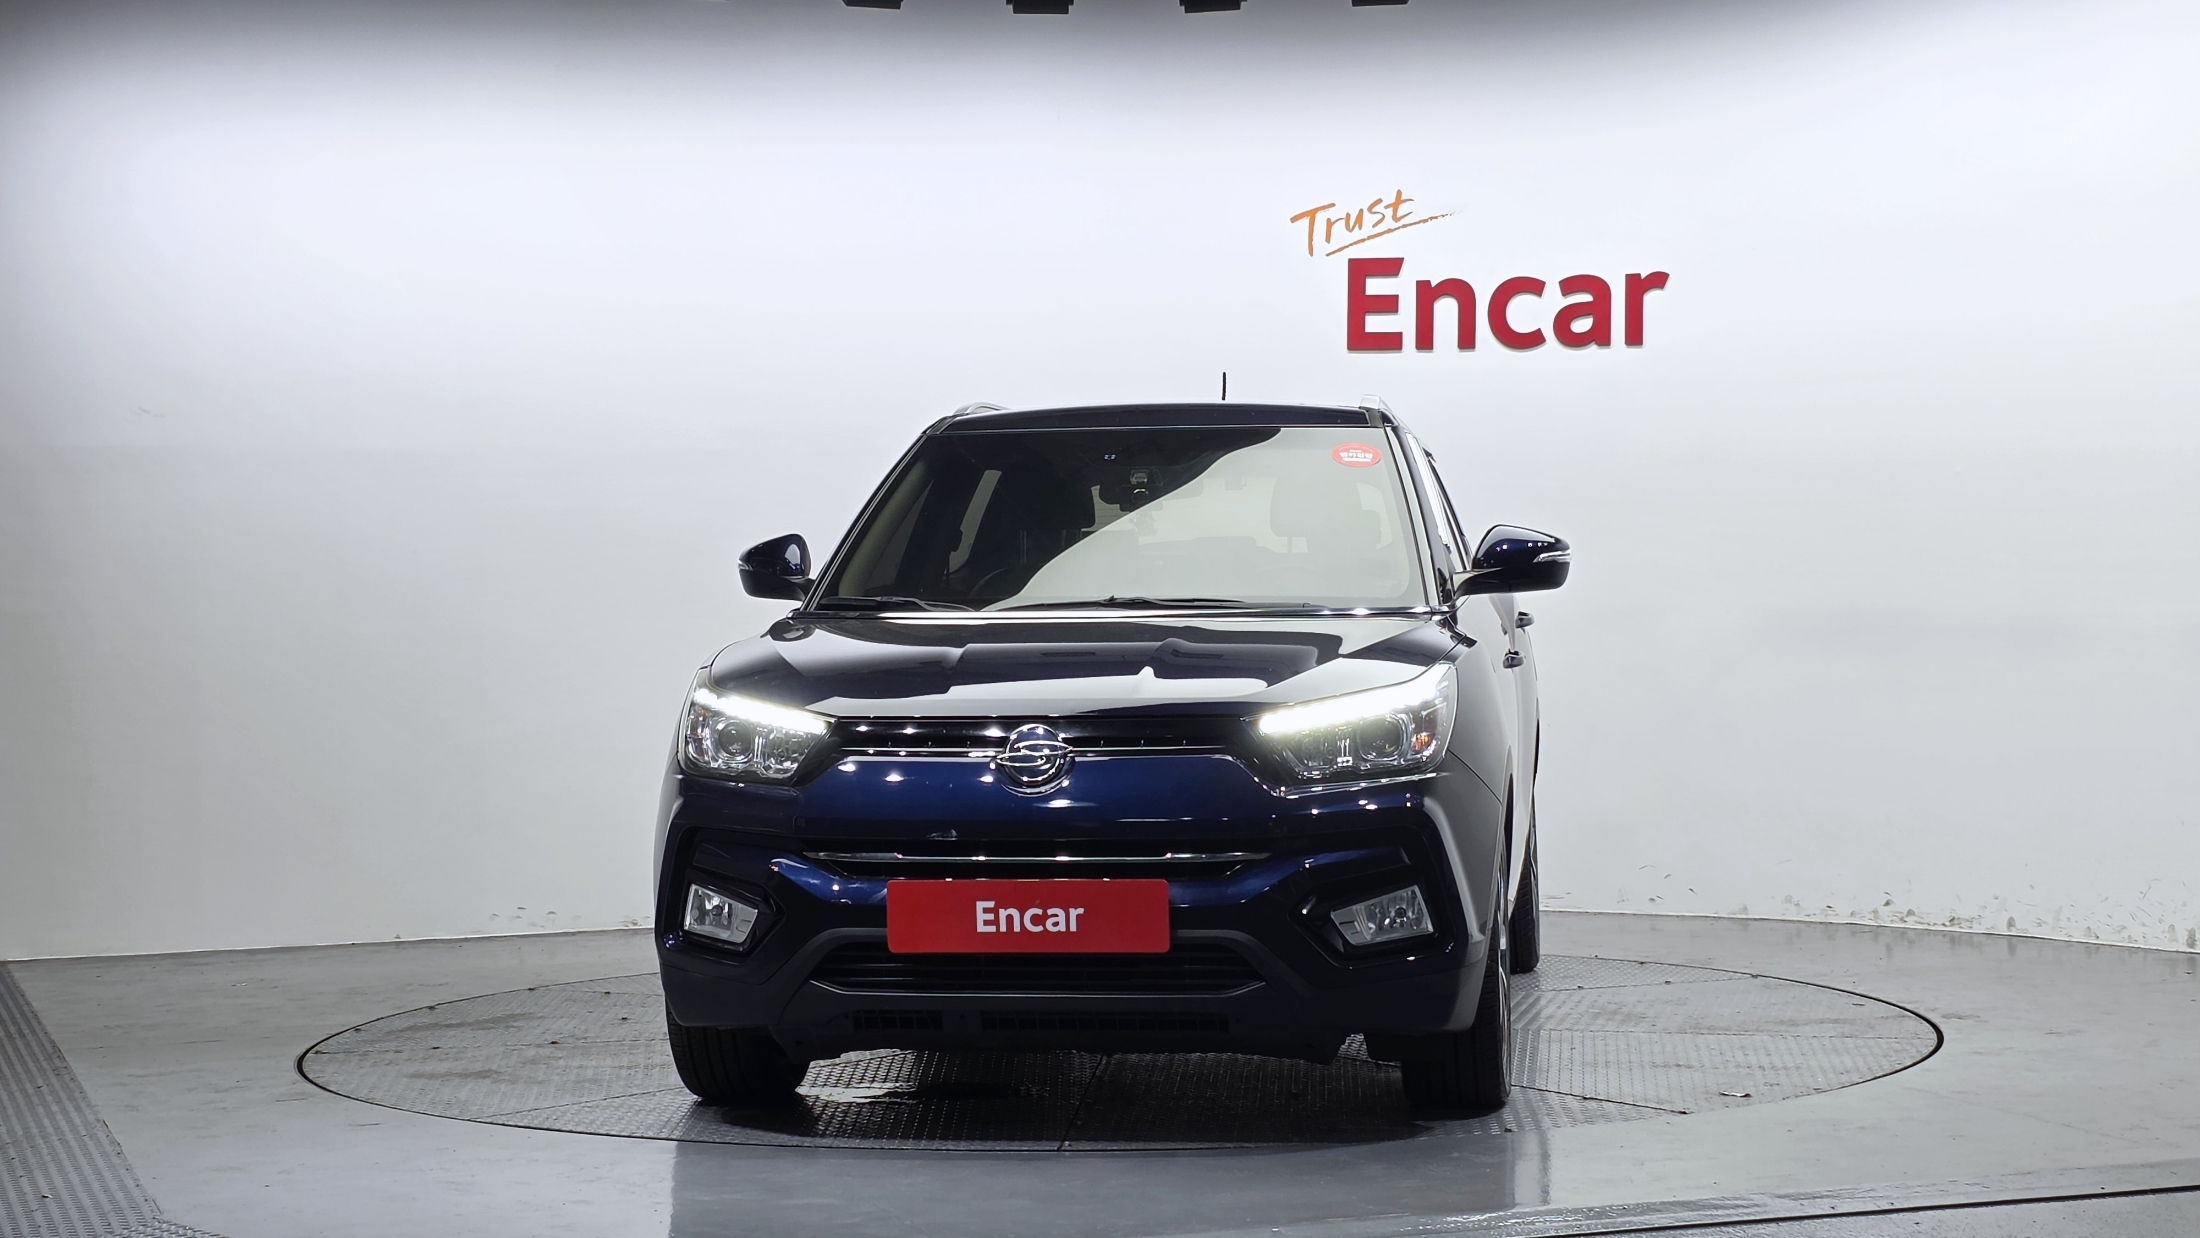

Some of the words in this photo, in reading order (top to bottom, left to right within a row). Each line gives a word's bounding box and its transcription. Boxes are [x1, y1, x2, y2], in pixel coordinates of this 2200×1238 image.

[1290, 189, 1414, 256] Trust
[1347, 257, 1669, 351] Encar
[975, 900, 1085, 933] Encar
